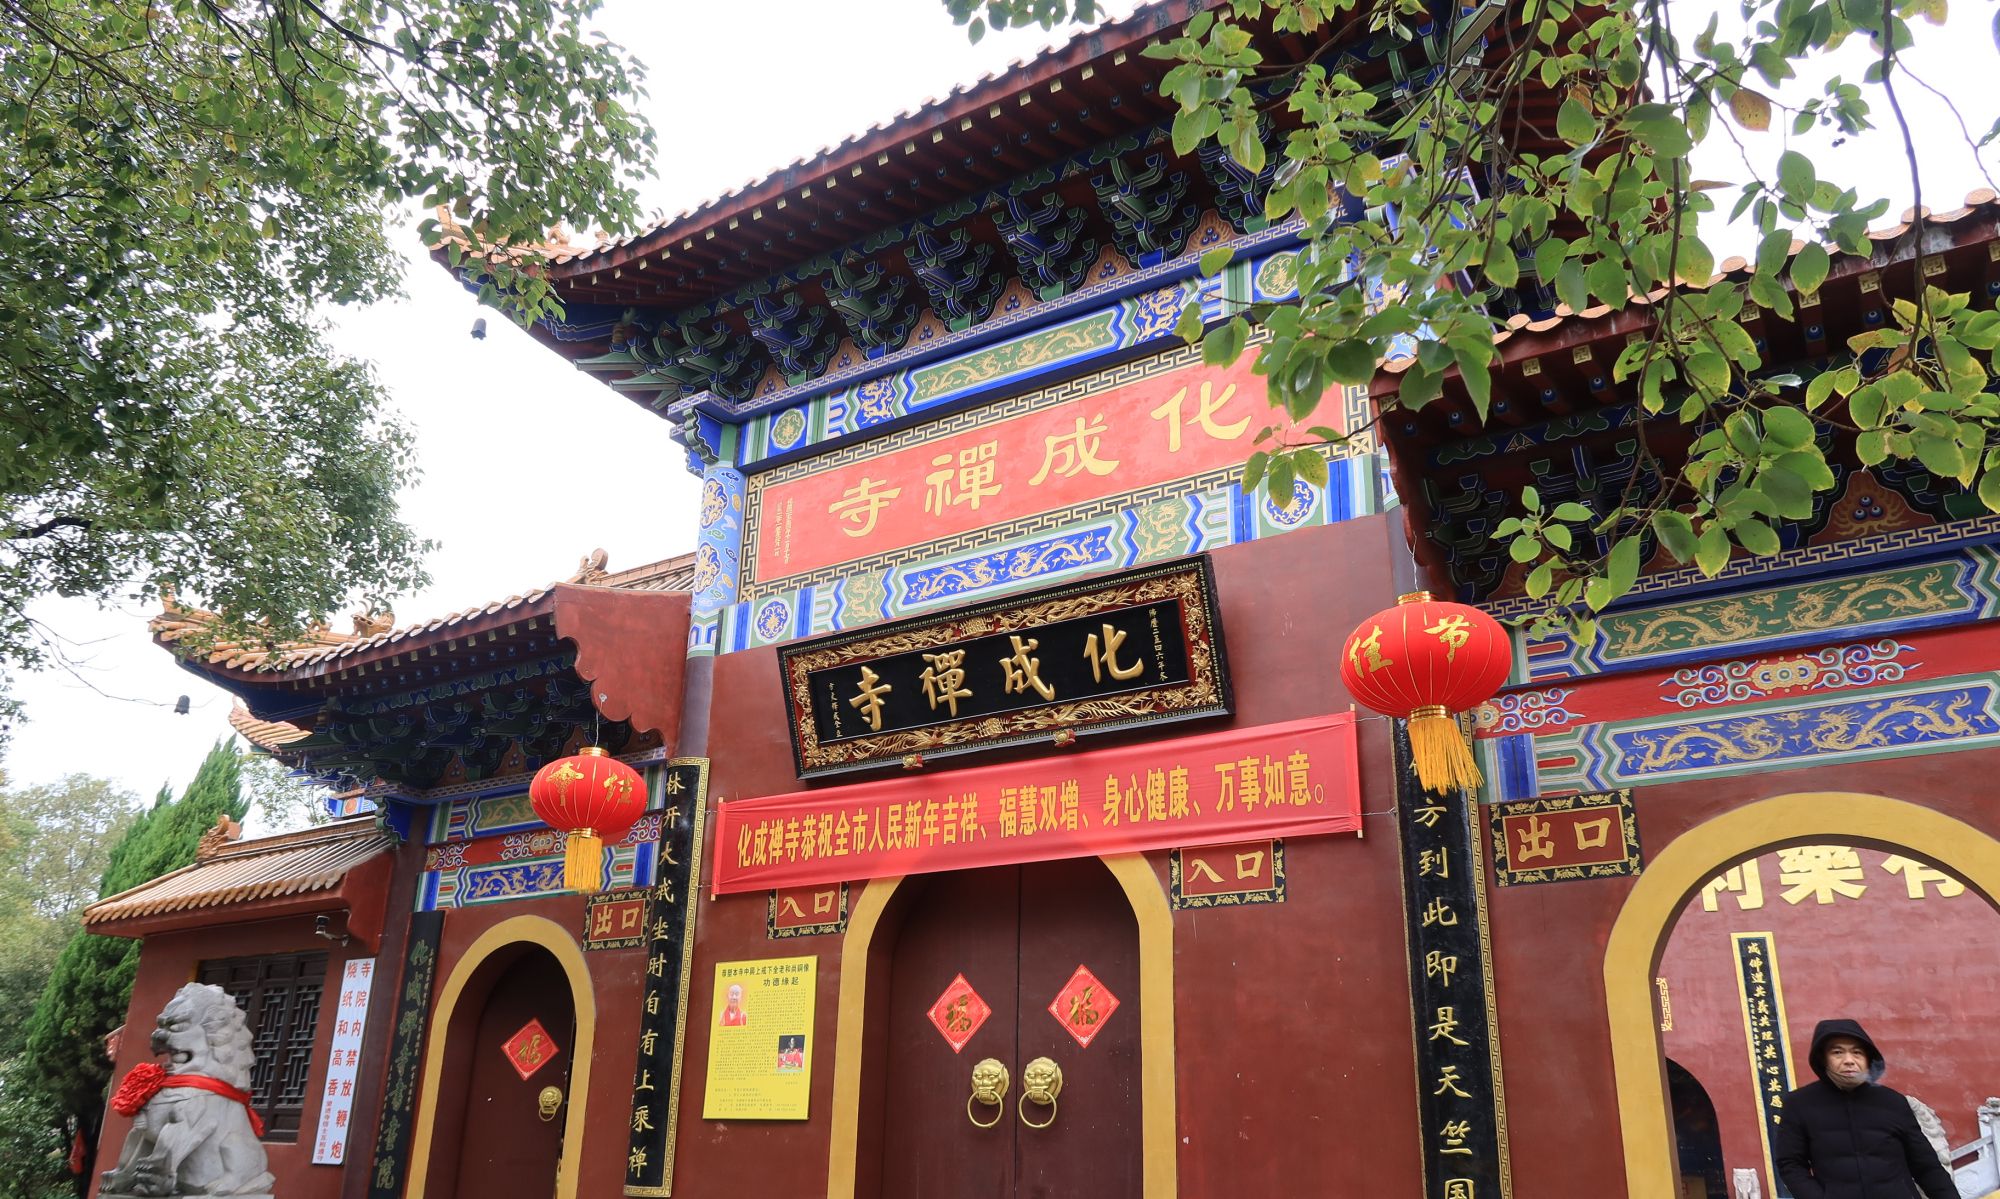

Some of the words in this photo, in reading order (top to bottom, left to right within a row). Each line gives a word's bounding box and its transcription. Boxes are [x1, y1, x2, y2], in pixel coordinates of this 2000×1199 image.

[828, 380, 1252, 537] 化成禪寺
[848, 623, 1144, 731] 化成禪寺
[1516, 815, 1611, 863] 出口
[1187, 850, 1265, 883] 入口
[594, 904, 640, 937] 出口
[778, 890, 836, 918] 入口
[1408, 757, 1475, 1199] 方到此即是天竺国
[945, 994, 972, 1032] 福
[1069, 985, 1099, 1026] 福
